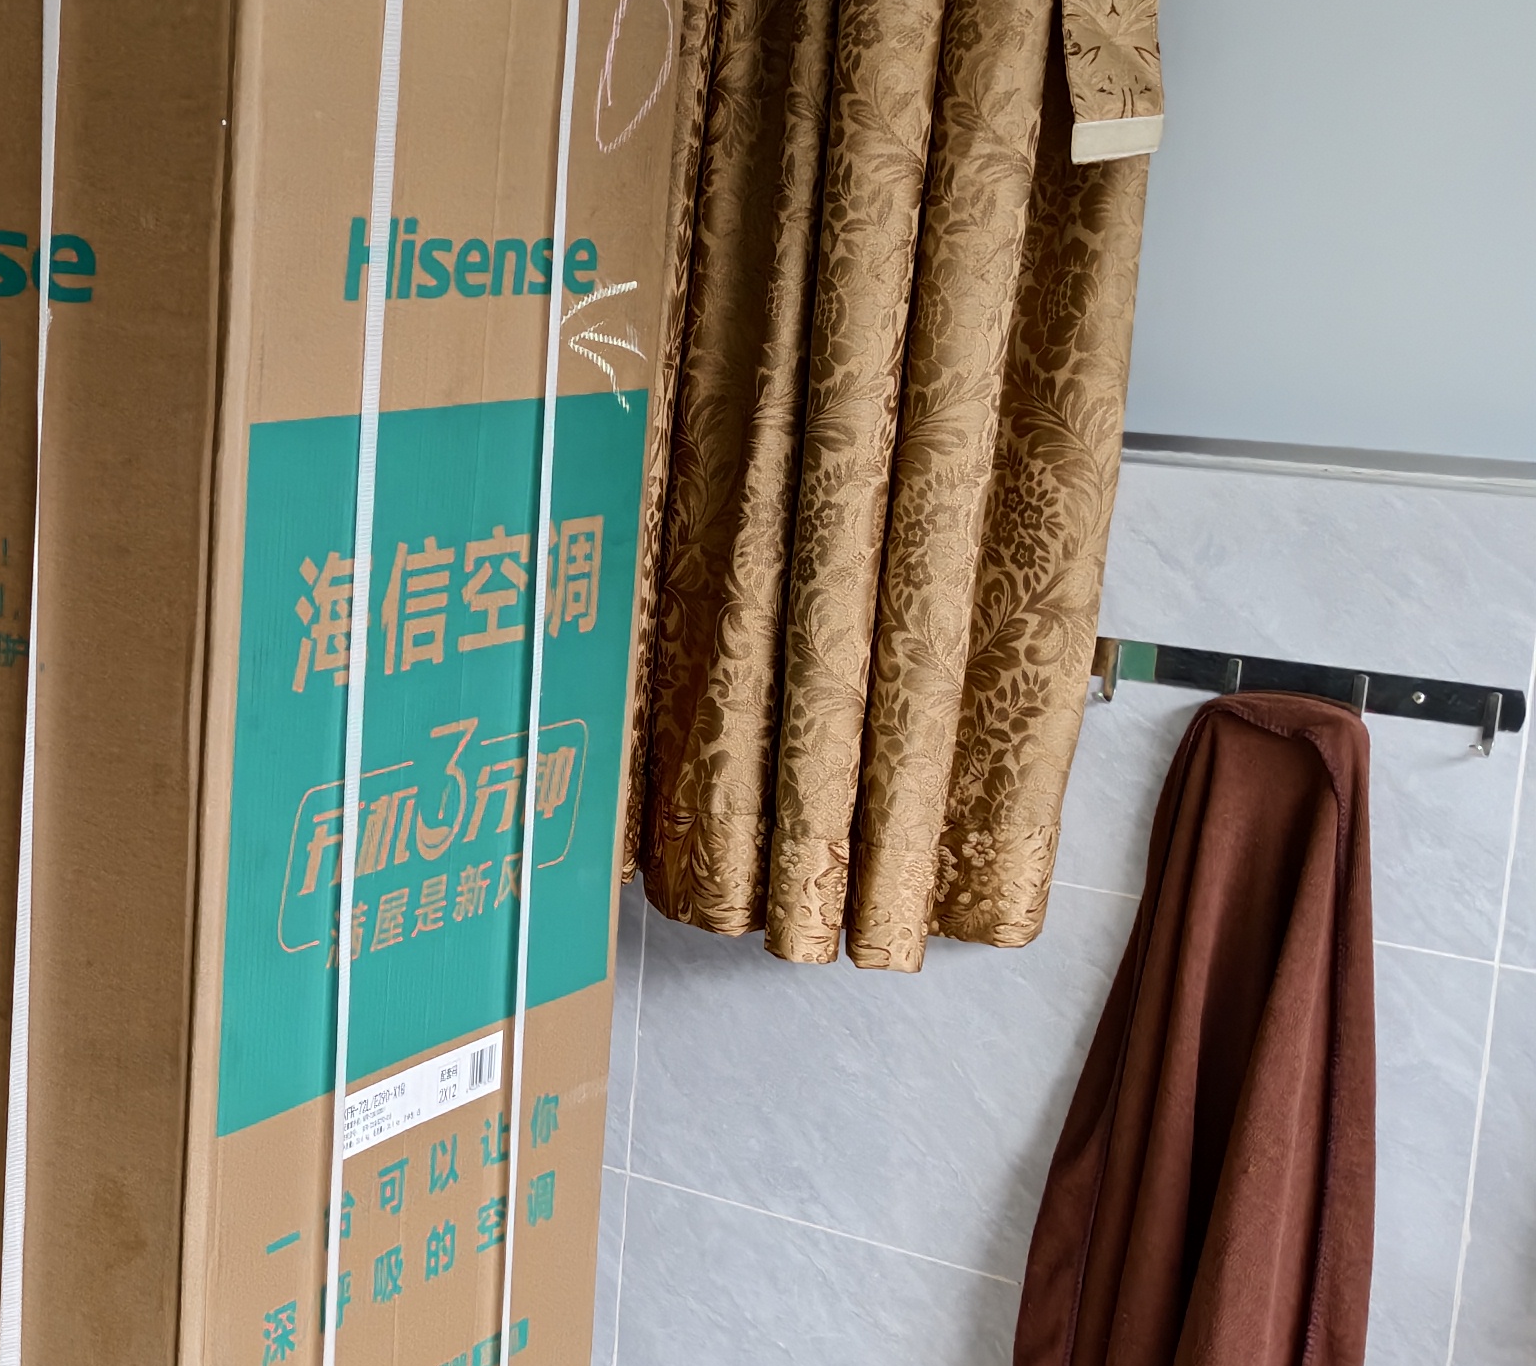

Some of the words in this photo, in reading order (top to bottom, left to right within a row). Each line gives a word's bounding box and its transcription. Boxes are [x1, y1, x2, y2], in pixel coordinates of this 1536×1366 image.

[344, 216, 598, 302] Hisense
[292, 514, 604, 693] 海信空调
